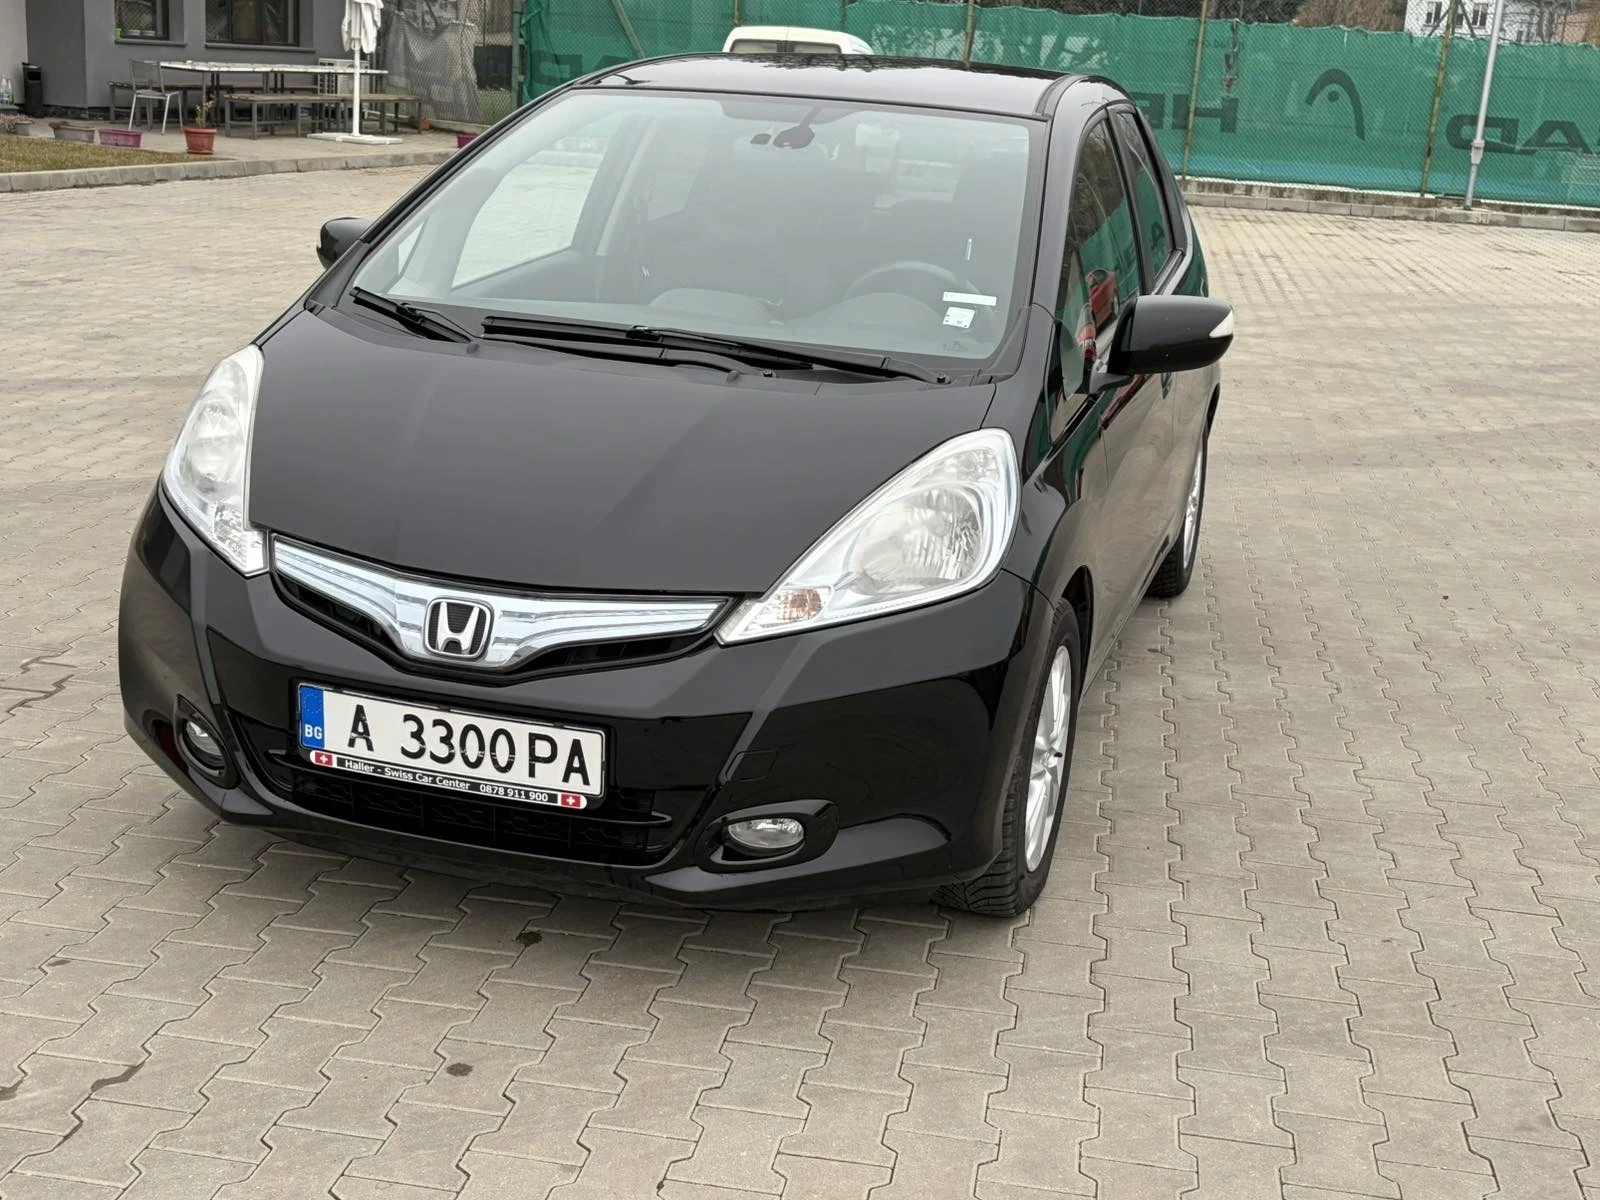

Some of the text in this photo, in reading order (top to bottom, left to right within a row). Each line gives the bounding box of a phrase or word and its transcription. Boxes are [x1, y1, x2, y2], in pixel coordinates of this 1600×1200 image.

[304, 724, 323, 740] BG
[347, 704, 591, 786] A 3300 PA
[345, 759, 375, 773] Haller
[384, 767, 414, 781] Swiss
[416, 773, 433, 784] Car
[436, 776, 471, 791] Center
[479, 783, 505, 797] 0878
[507, 788, 526, 800] 911
[529, 791, 549, 802] 900
